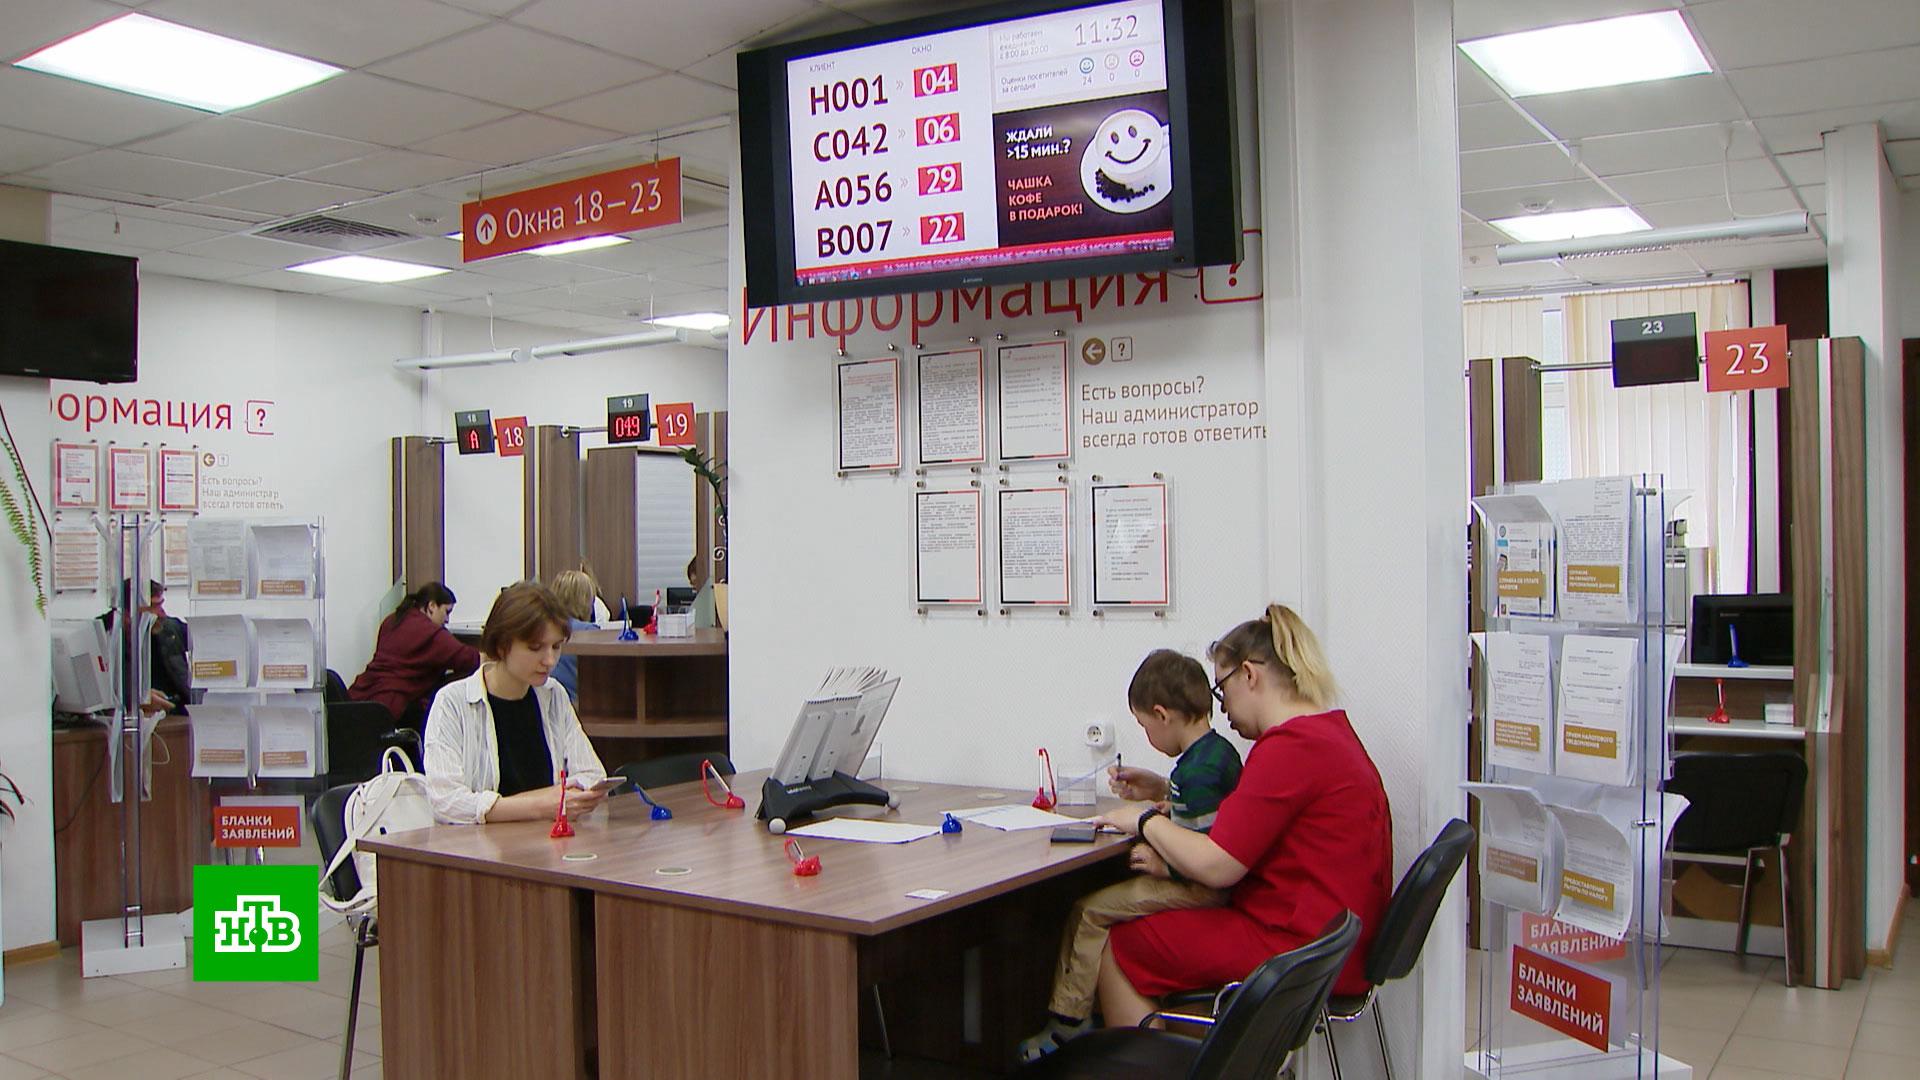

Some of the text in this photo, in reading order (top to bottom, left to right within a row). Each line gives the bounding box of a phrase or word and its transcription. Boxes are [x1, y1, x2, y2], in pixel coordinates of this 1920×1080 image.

[1075, 14, 1138, 46] 11:32
[911, 44, 932, 55] ОКНО
[809, 62, 836, 72] КЛИЕНТ
[921, 66, 954, 95] 04
[923, 115, 955, 145] 06
[1006, 126, 1053, 143] ЖДАЛИ
[1031, 138, 1072, 157] МИН.?
[926, 165, 957, 194] 29
[1008, 176, 1053, 191] ЧАШКА
[1009, 192, 1043, 207] КОФЕ
[1009, 203, 1083, 221] В ПОДАРОК!
[506, 206, 565, 239] Окна
[928, 215, 958, 243] 22
[1641, 320, 1664, 335] 23
[1726, 341, 1769, 376] 23
[1082, 376, 1205, 401] Есть вопросы?
[50, 393, 232, 433] ормация
[622, 398, 634, 408] 19
[1082, 401, 1259, 425] Наш администратор
[615, 416, 640, 438] 049
[665, 412, 689, 438] 19
[504, 427, 524, 448] 18
[1083, 432, 1137, 449] всегда
[1143, 430, 1188, 446] готов
[203, 475, 263, 486] Есть вопросы?
[203, 487, 221, 497] Наш
[222, 815, 272, 826] БЛАНКИ
[221, 826, 295, 839] ЗАЯВЛЕНИЙ
[1530, 921, 1588, 938] БЛАН
[1518, 962, 1577, 1000] БЛАНКИ
[1517, 985, 1603, 1035] ЗАЯВЛЕНИЙ
